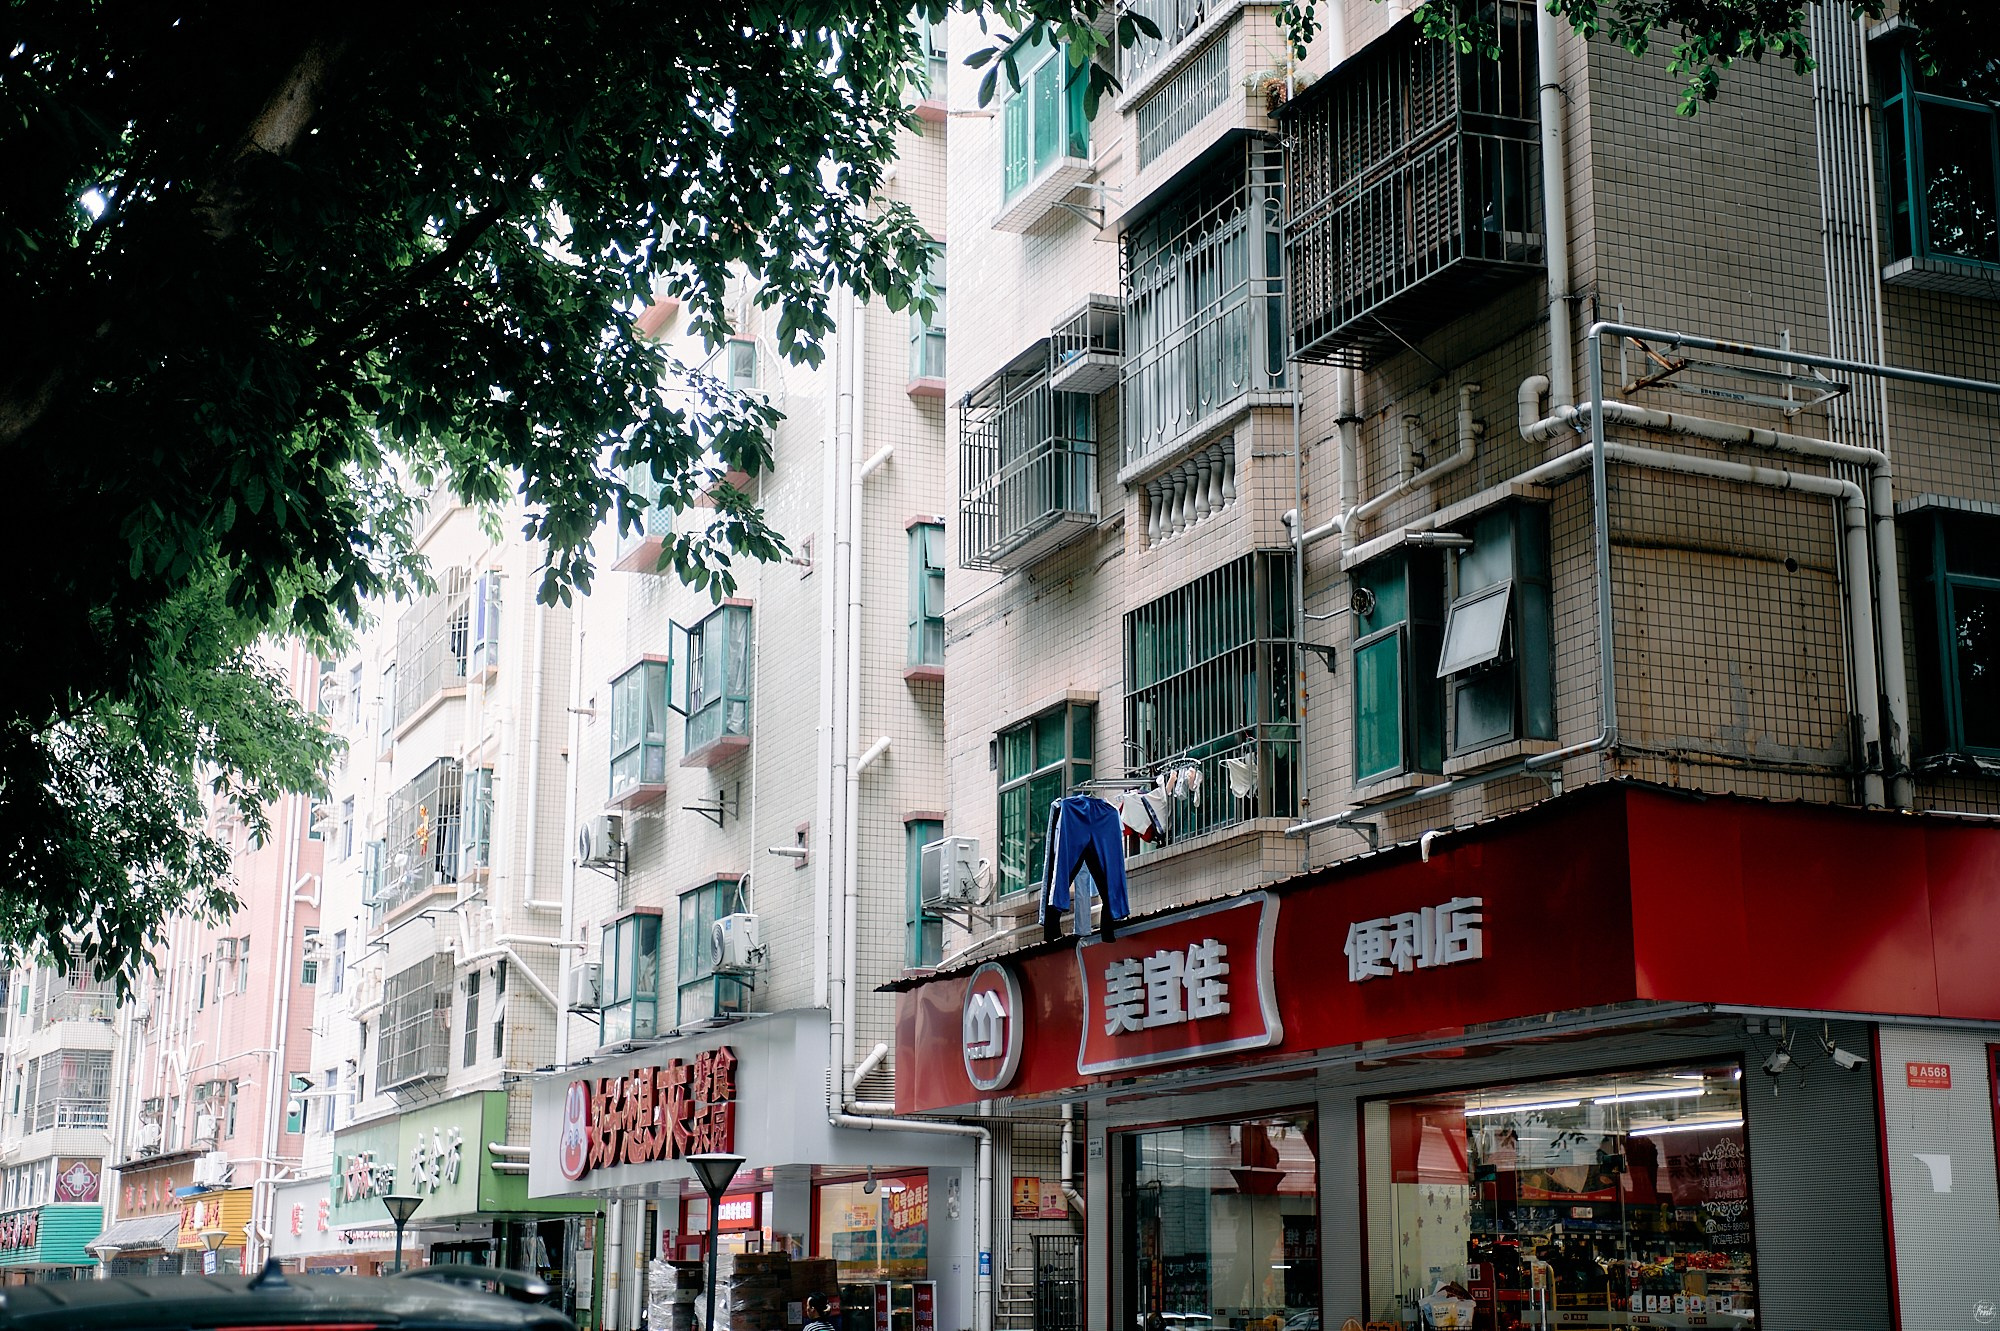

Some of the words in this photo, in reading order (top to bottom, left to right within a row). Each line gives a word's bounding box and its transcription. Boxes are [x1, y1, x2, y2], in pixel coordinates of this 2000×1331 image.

[1345, 897, 1483, 982] 便利店
[1105, 938, 1230, 1036] 美宜佳
[1920, 1066, 1947, 1078] A568
[589, 1058, 695, 1170] 好想来
[692, 1101, 736, 1155] 乐园
[1709, 1159, 1746, 1170] WELCOME
